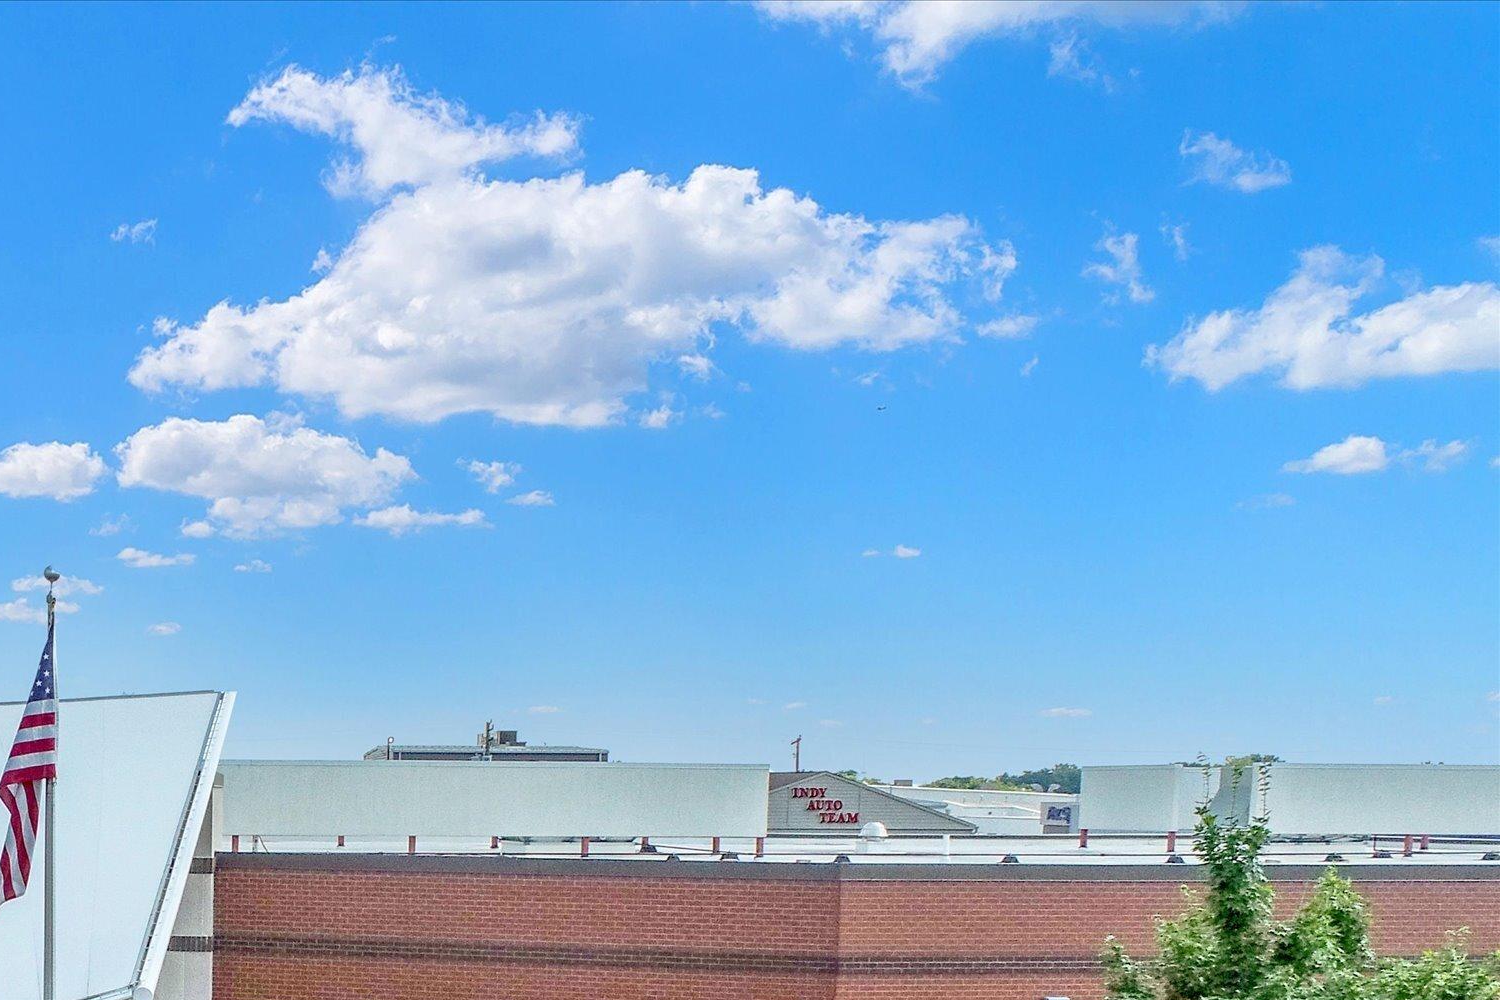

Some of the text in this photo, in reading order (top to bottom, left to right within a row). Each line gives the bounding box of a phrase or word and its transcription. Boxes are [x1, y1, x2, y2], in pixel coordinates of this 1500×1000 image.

[791, 787, 828, 798] INDY
[806, 800, 843, 811] AUTO
[819, 812, 859, 824] TEAM
